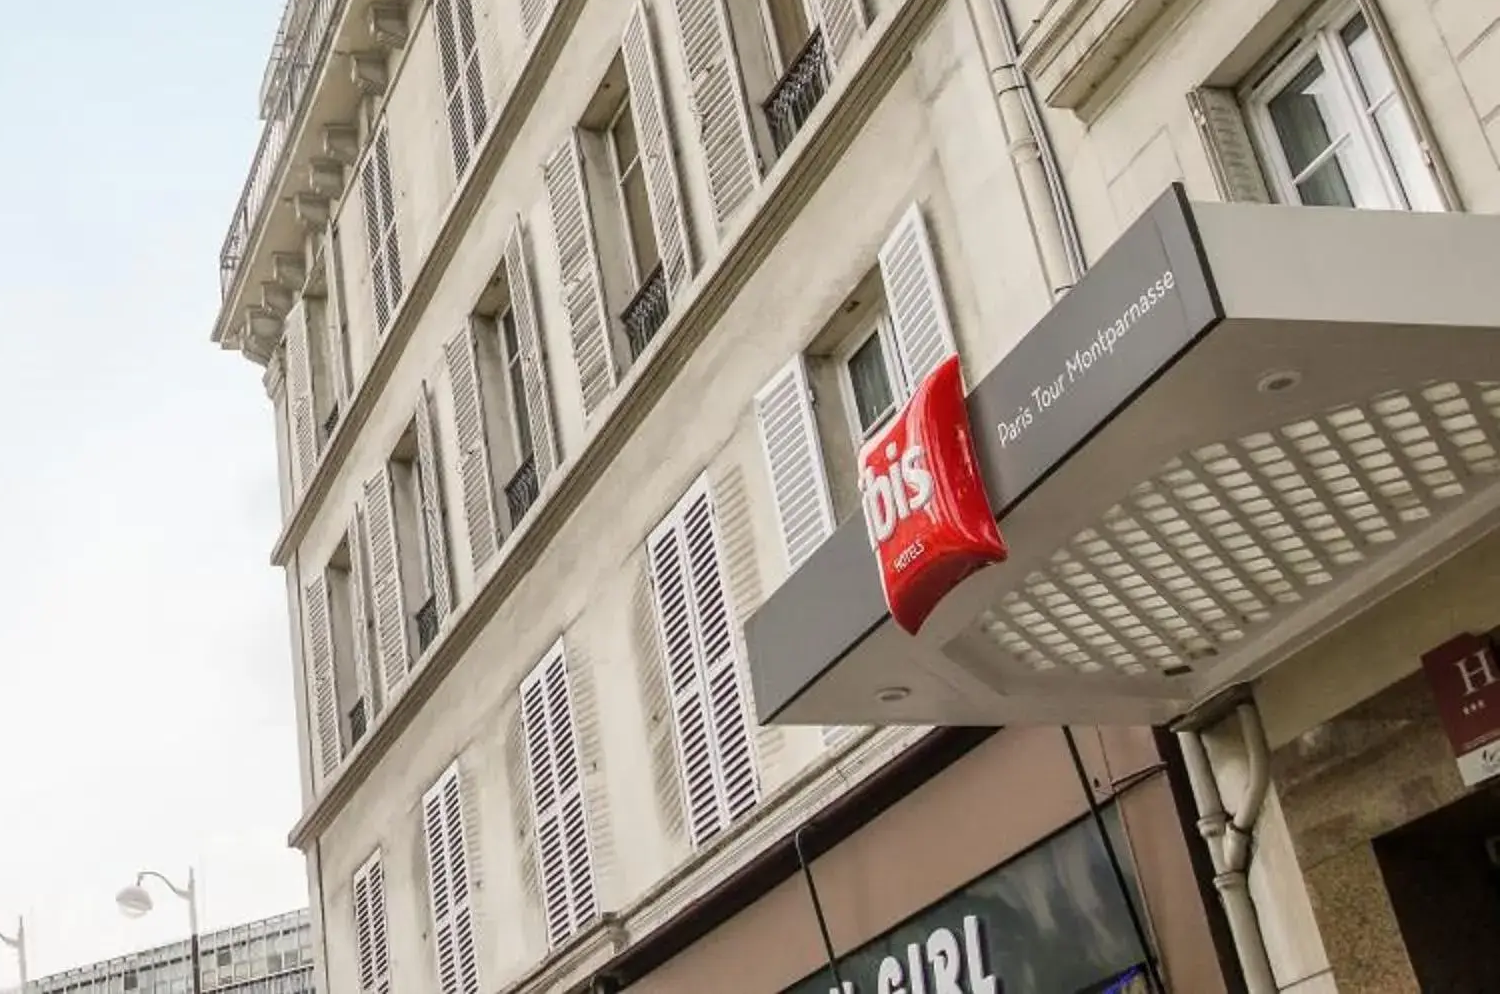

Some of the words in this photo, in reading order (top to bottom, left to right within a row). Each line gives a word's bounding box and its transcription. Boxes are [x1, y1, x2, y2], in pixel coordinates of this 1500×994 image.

[997, 407, 1033, 447] Paris
[1031, 373, 1068, 413] Tour
[1065, 270, 1175, 382] Montparnasse
[1453, 648, 1500, 695] H
